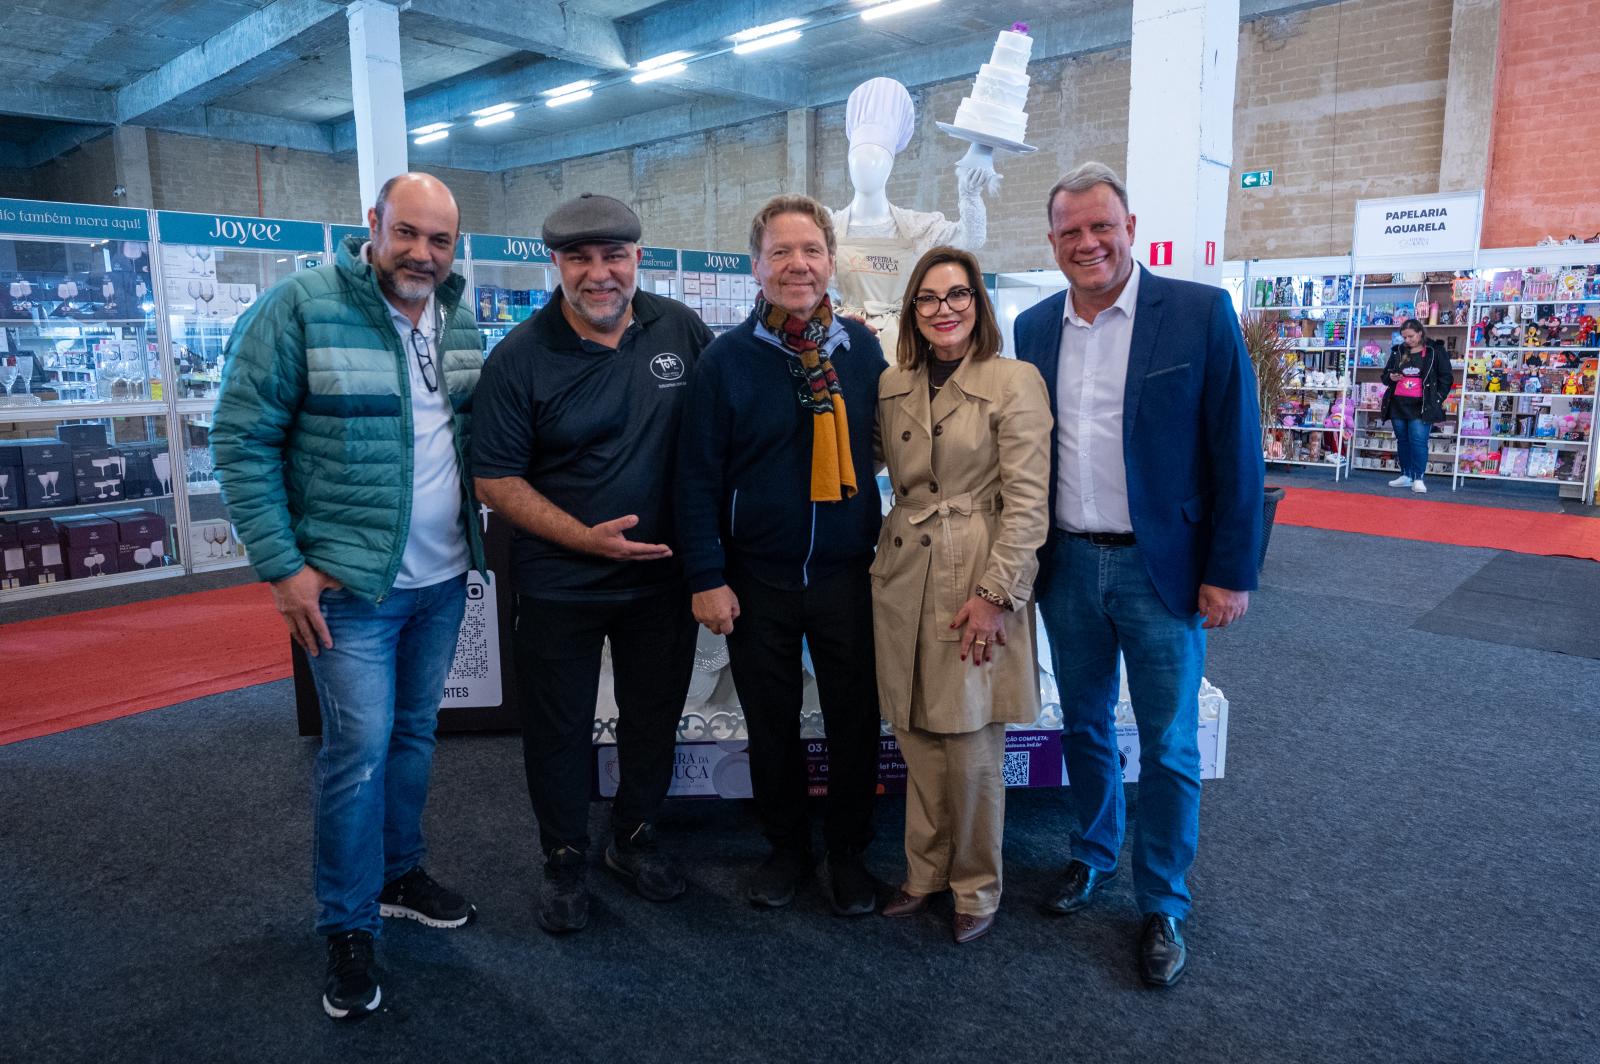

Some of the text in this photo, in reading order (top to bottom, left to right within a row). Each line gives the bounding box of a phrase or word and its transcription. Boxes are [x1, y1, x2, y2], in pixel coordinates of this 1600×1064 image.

[0, 209, 142, 231] ilo também mora aqui!
[1386, 208, 1447, 220] PAPELARIA
[209, 217, 281, 245] Joyee
[1384, 222, 1446, 234] AQUARELA
[503, 238, 552, 260] Joyee
[639, 259, 673, 268] ansformar!
[704, 253, 740, 271] Joyee
[443, 687, 469, 698] RTES
[1005, 735, 1018, 743] ÇÃO
[807, 743, 822, 753] 03
[674, 752, 696, 764] IRA
[675, 765, 709, 783] UÇA
